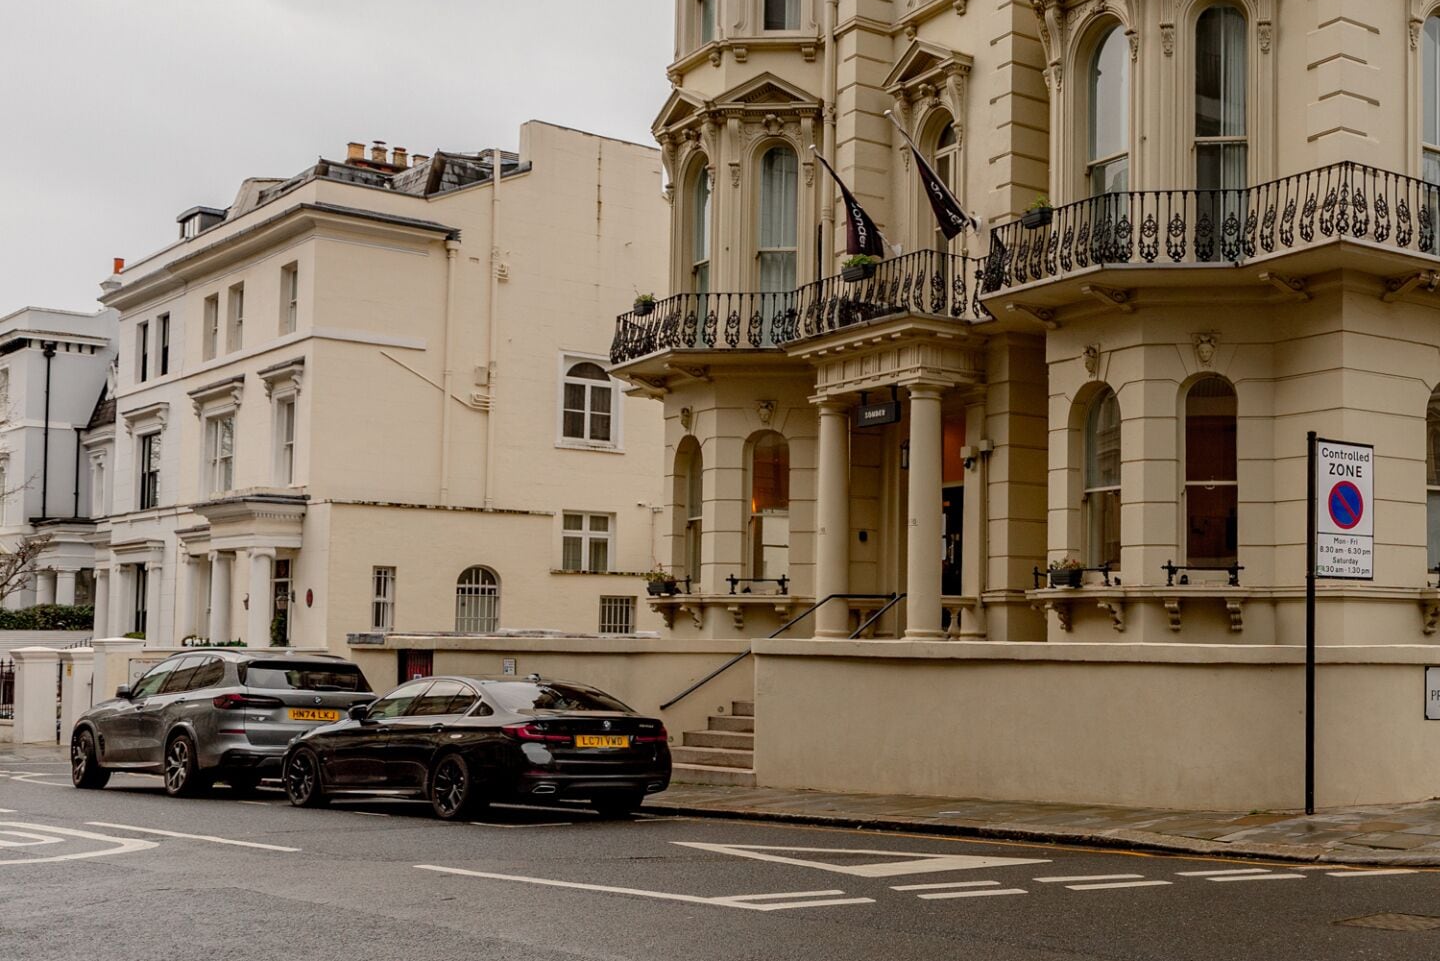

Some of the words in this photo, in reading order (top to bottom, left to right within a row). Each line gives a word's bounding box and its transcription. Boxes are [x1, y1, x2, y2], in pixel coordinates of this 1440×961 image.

[1321, 447, 1370, 462] Controlled
[1328, 462, 1362, 478] ZONE
[1347, 547, 1361, 555] 6.30
[1332, 556, 1359, 565] Saturday
